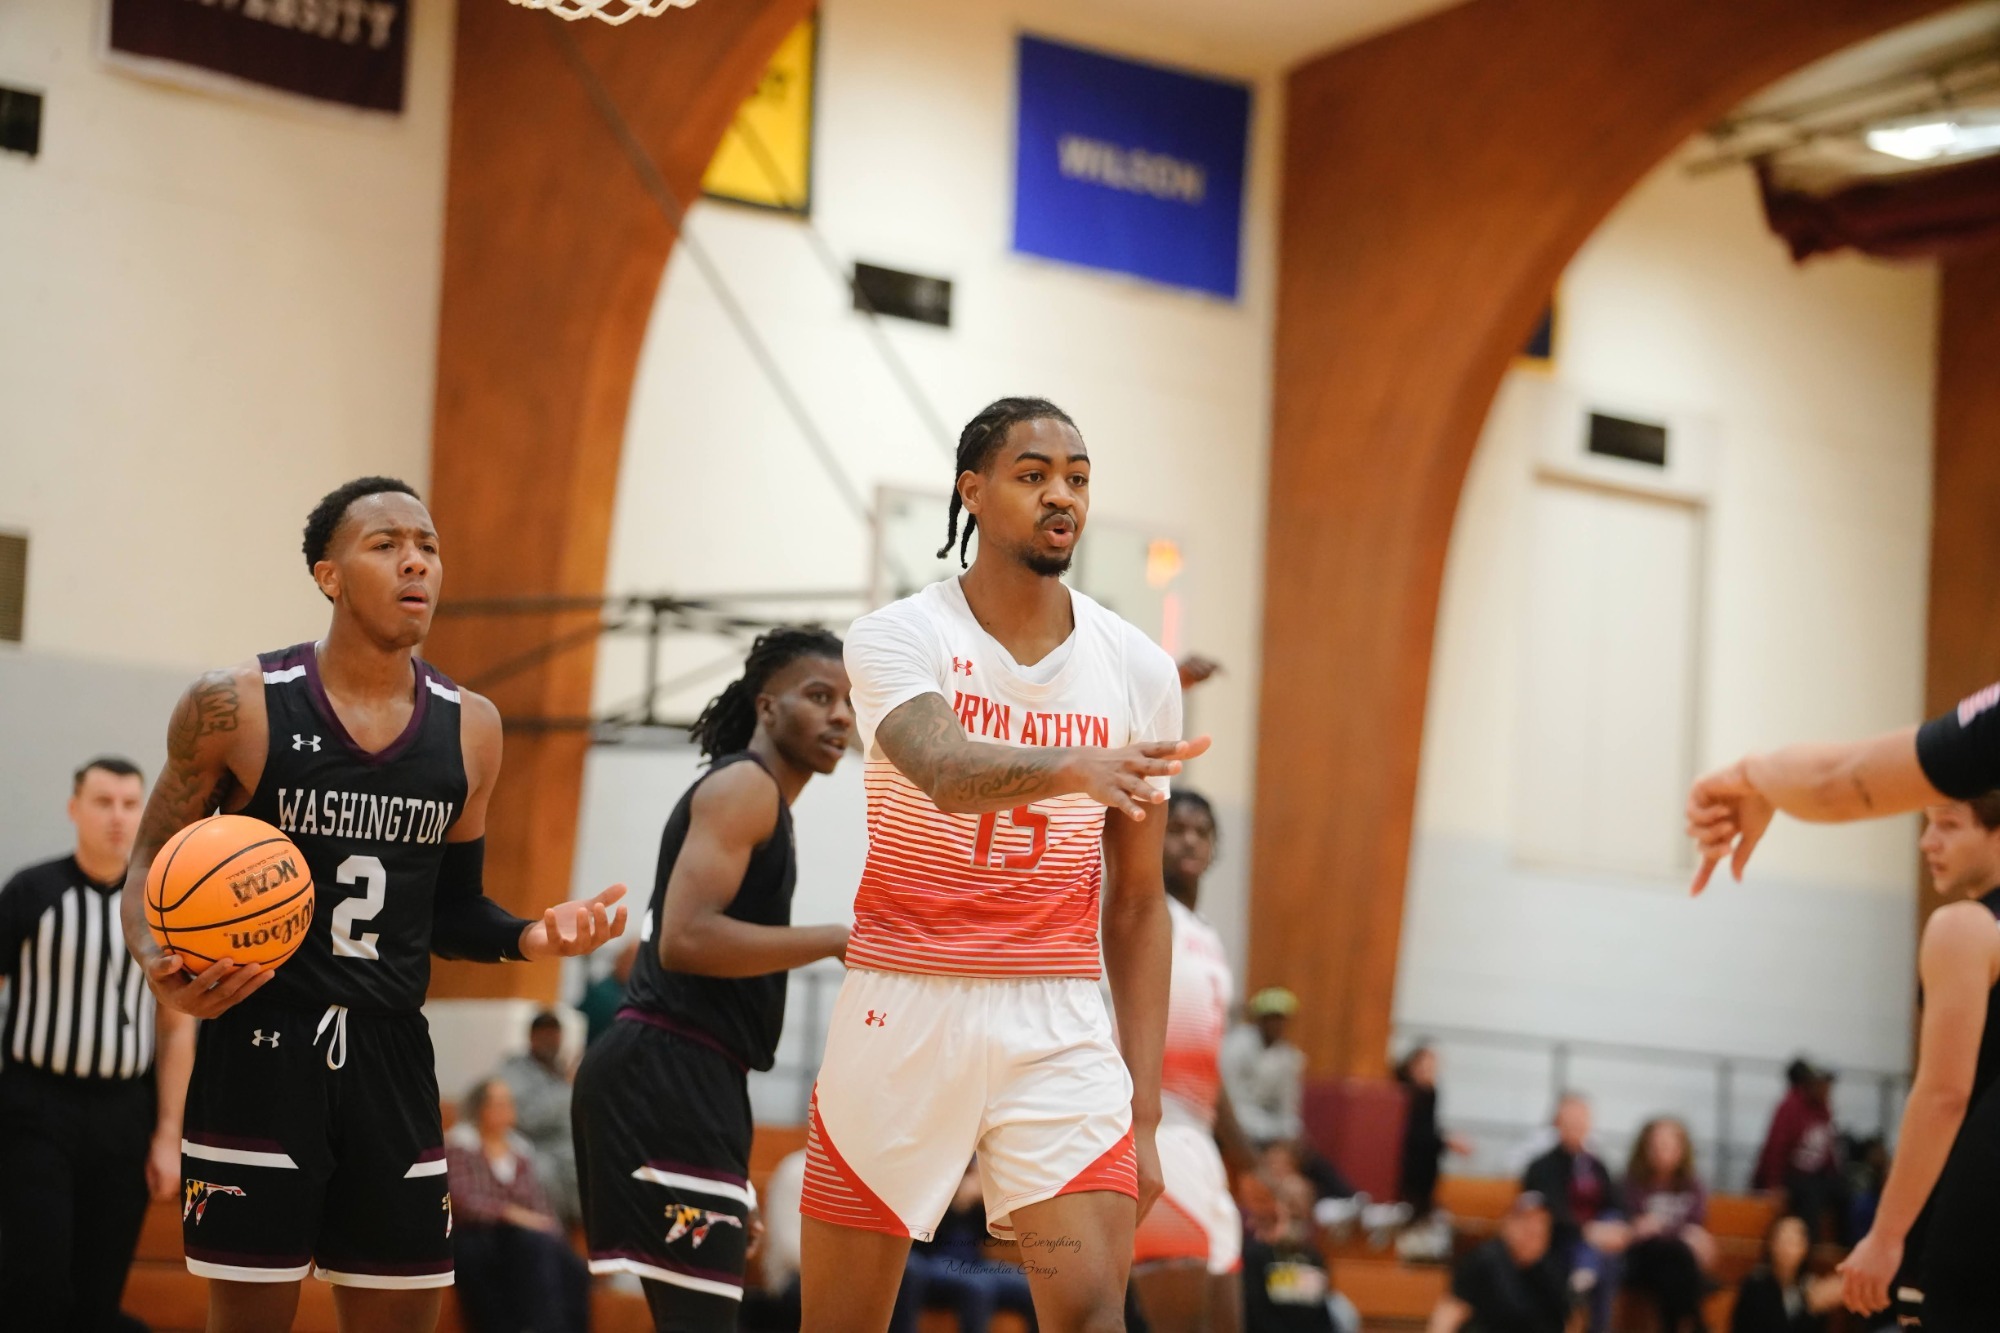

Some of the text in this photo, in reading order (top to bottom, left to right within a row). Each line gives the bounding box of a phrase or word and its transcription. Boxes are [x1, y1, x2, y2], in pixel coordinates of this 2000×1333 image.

[1057, 133, 1206, 204] WILSON
[1020, 711, 1109, 748] ATHYN
[278, 788, 453, 845] WASHINGTON
[969, 804, 1051, 872] 15
[229, 856, 299, 904] NCAA
[331, 855, 387, 961] 2
[230, 896, 314, 949] Wilson
